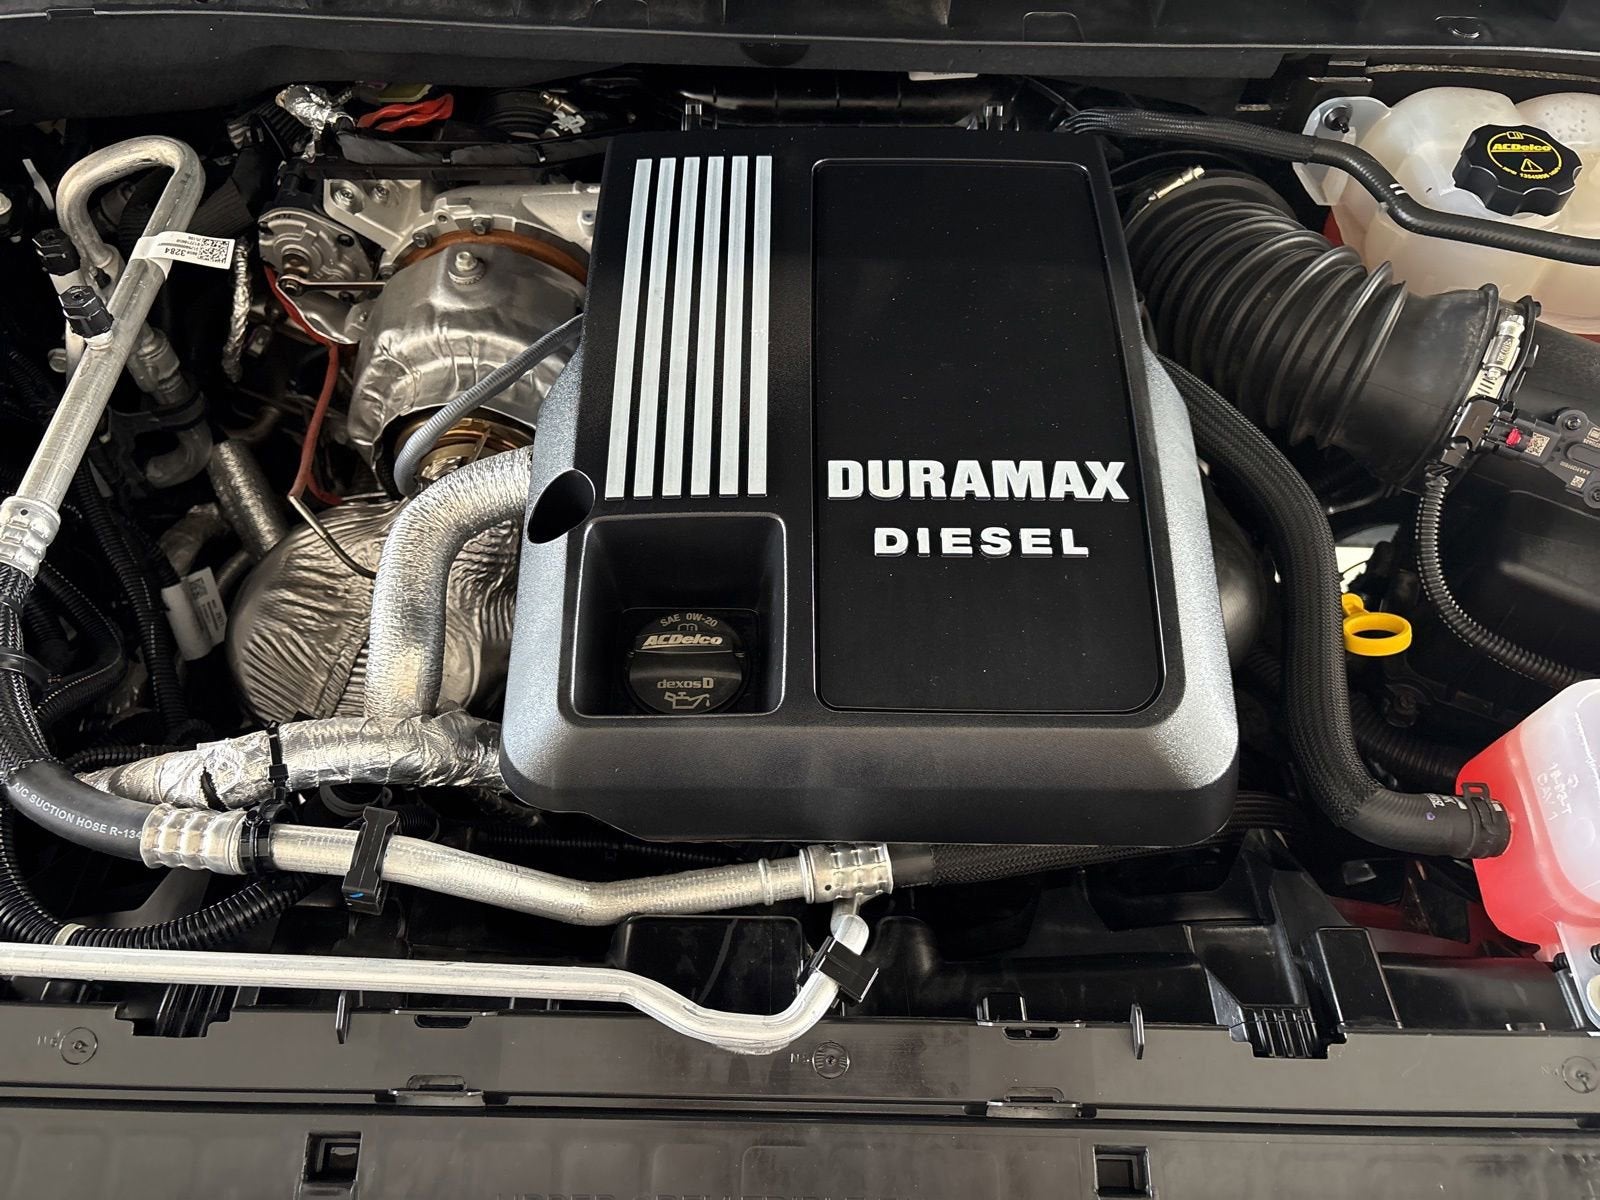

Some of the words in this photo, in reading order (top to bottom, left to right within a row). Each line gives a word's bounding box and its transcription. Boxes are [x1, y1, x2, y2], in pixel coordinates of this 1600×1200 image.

[1490, 143, 1552, 152] ACDelco
[164, 247, 187, 257] 3284
[827, 460, 1130, 501] DURAMAX
[874, 526, 1089, 557] DIESEL
[660, 613, 681, 627] SAE
[686, 612, 718, 627] 0W-20
[642, 634, 723, 647] ACDelco
[12, 782, 30, 798] A/C
[28, 794, 75, 823] SUCTION
[75, 816, 108, 834] HOSE
